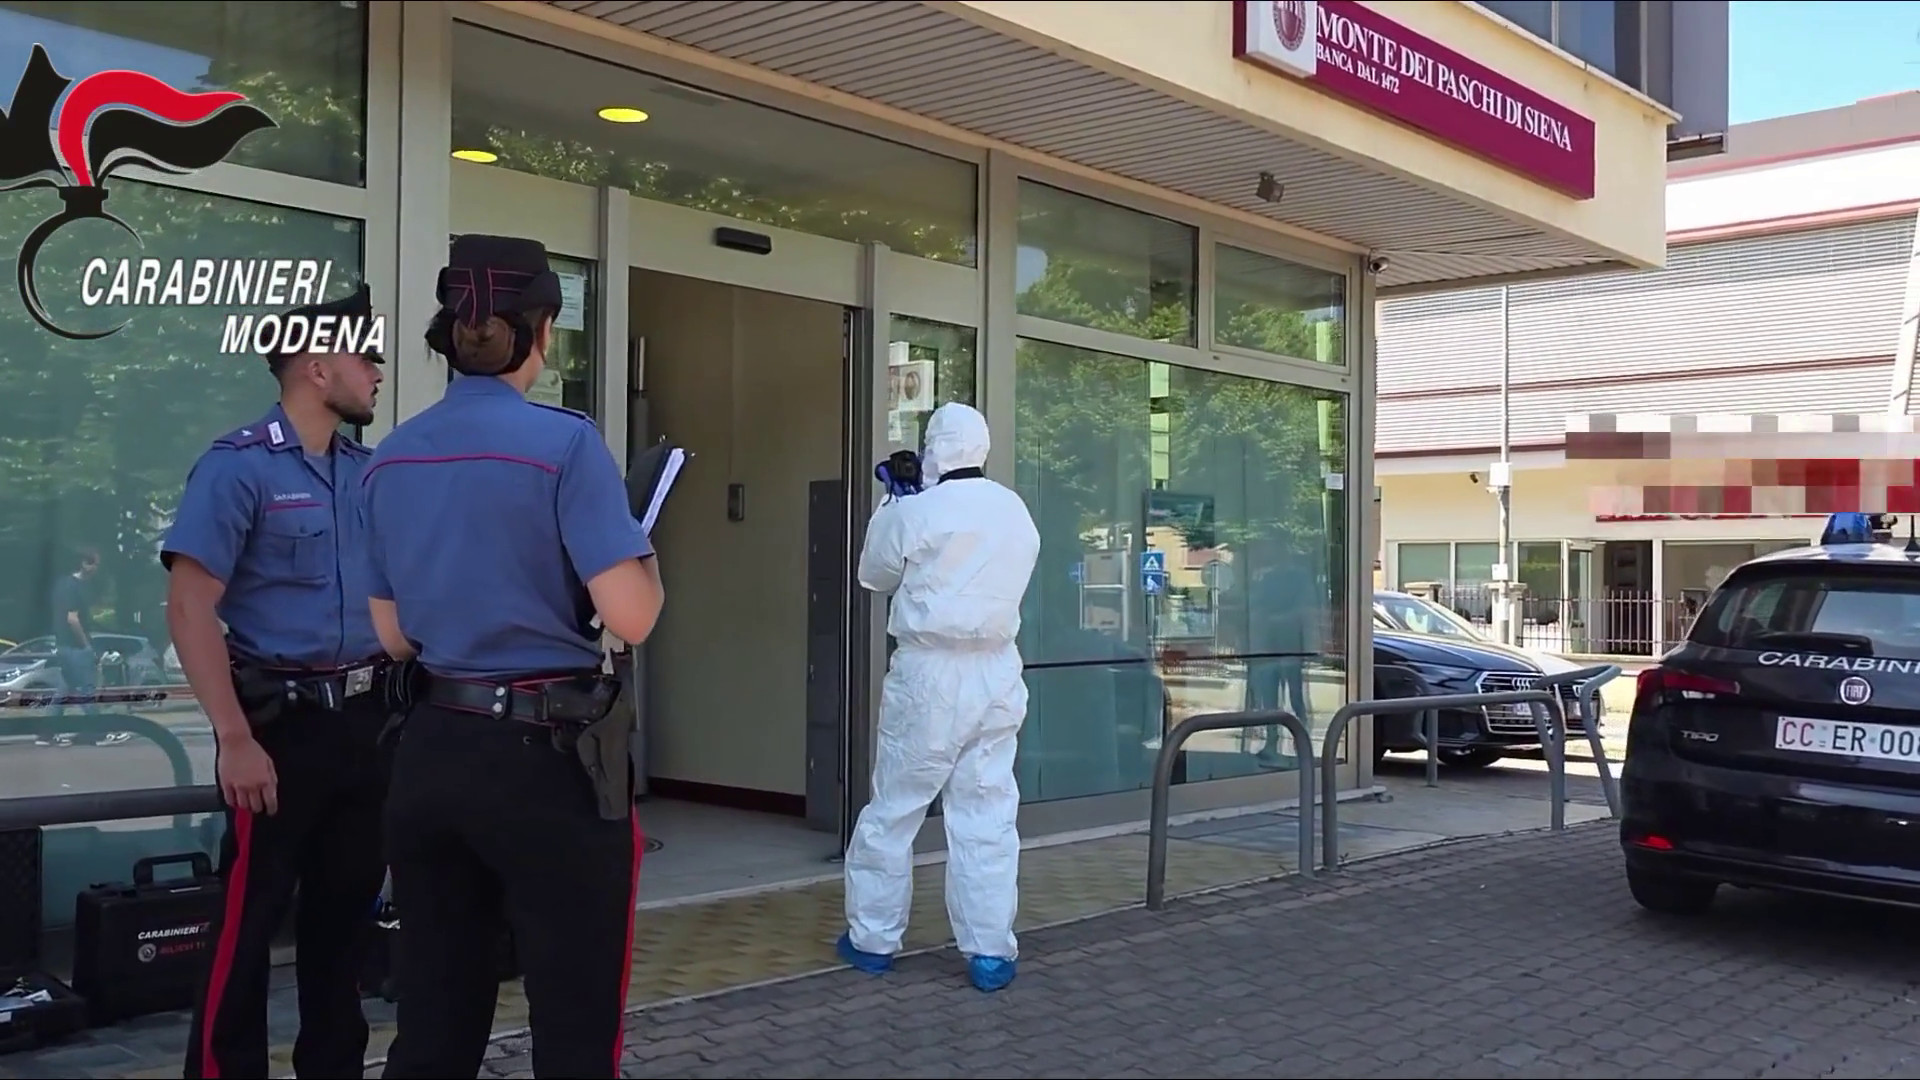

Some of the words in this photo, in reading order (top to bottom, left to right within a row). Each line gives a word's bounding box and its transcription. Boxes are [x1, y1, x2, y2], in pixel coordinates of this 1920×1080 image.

[1316, 42, 1354, 74] BANCA
[1357, 60, 1379, 85] DAL
[1381, 72, 1400, 94] 1472
[1317, 5, 1398, 71] MONTE
[1399, 44, 1434, 88] DEI
[1436, 62, 1502, 119] PASCHI
[1505, 95, 1523, 130] DI
[1524, 106, 1573, 152] SIENA
[1845, 685, 1866, 699] FIAT
[1782, 720, 1815, 748] CC
[1832, 724, 1867, 753] ER
[138, 926, 199, 939] CARABINIERI
